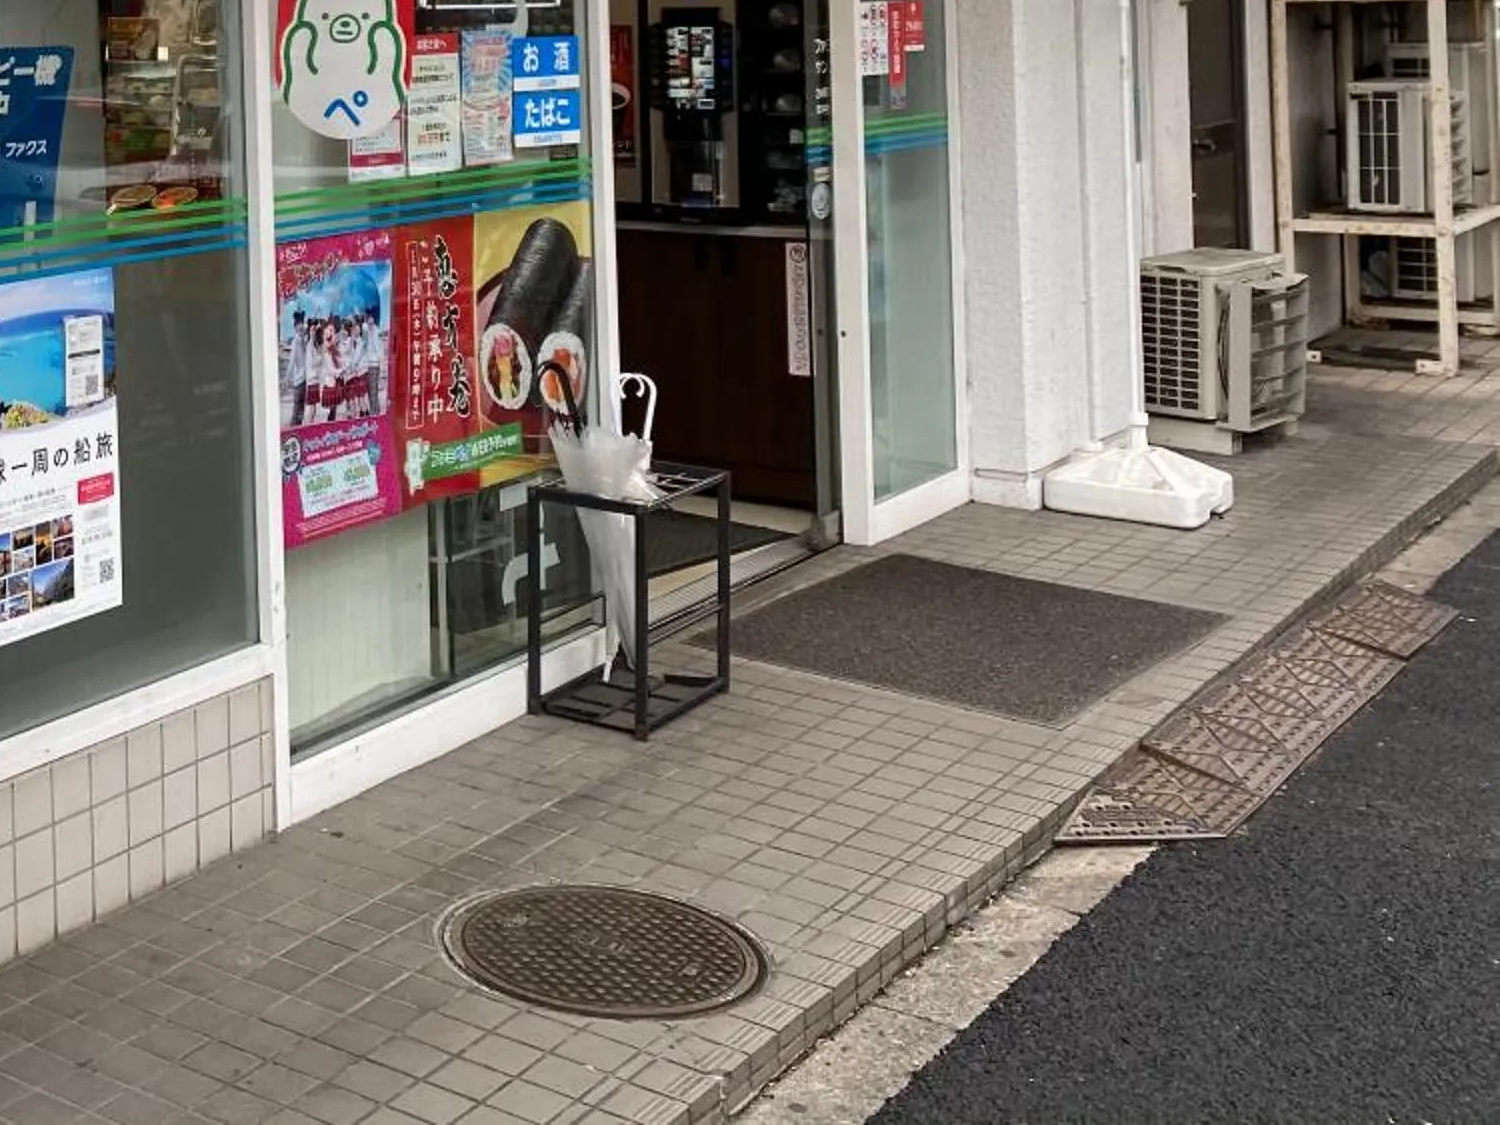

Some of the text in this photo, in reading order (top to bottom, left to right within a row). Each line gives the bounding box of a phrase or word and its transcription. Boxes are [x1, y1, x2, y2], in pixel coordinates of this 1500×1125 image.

[522, 40, 570, 73] お酒
[524, 97, 571, 129] たばこ
